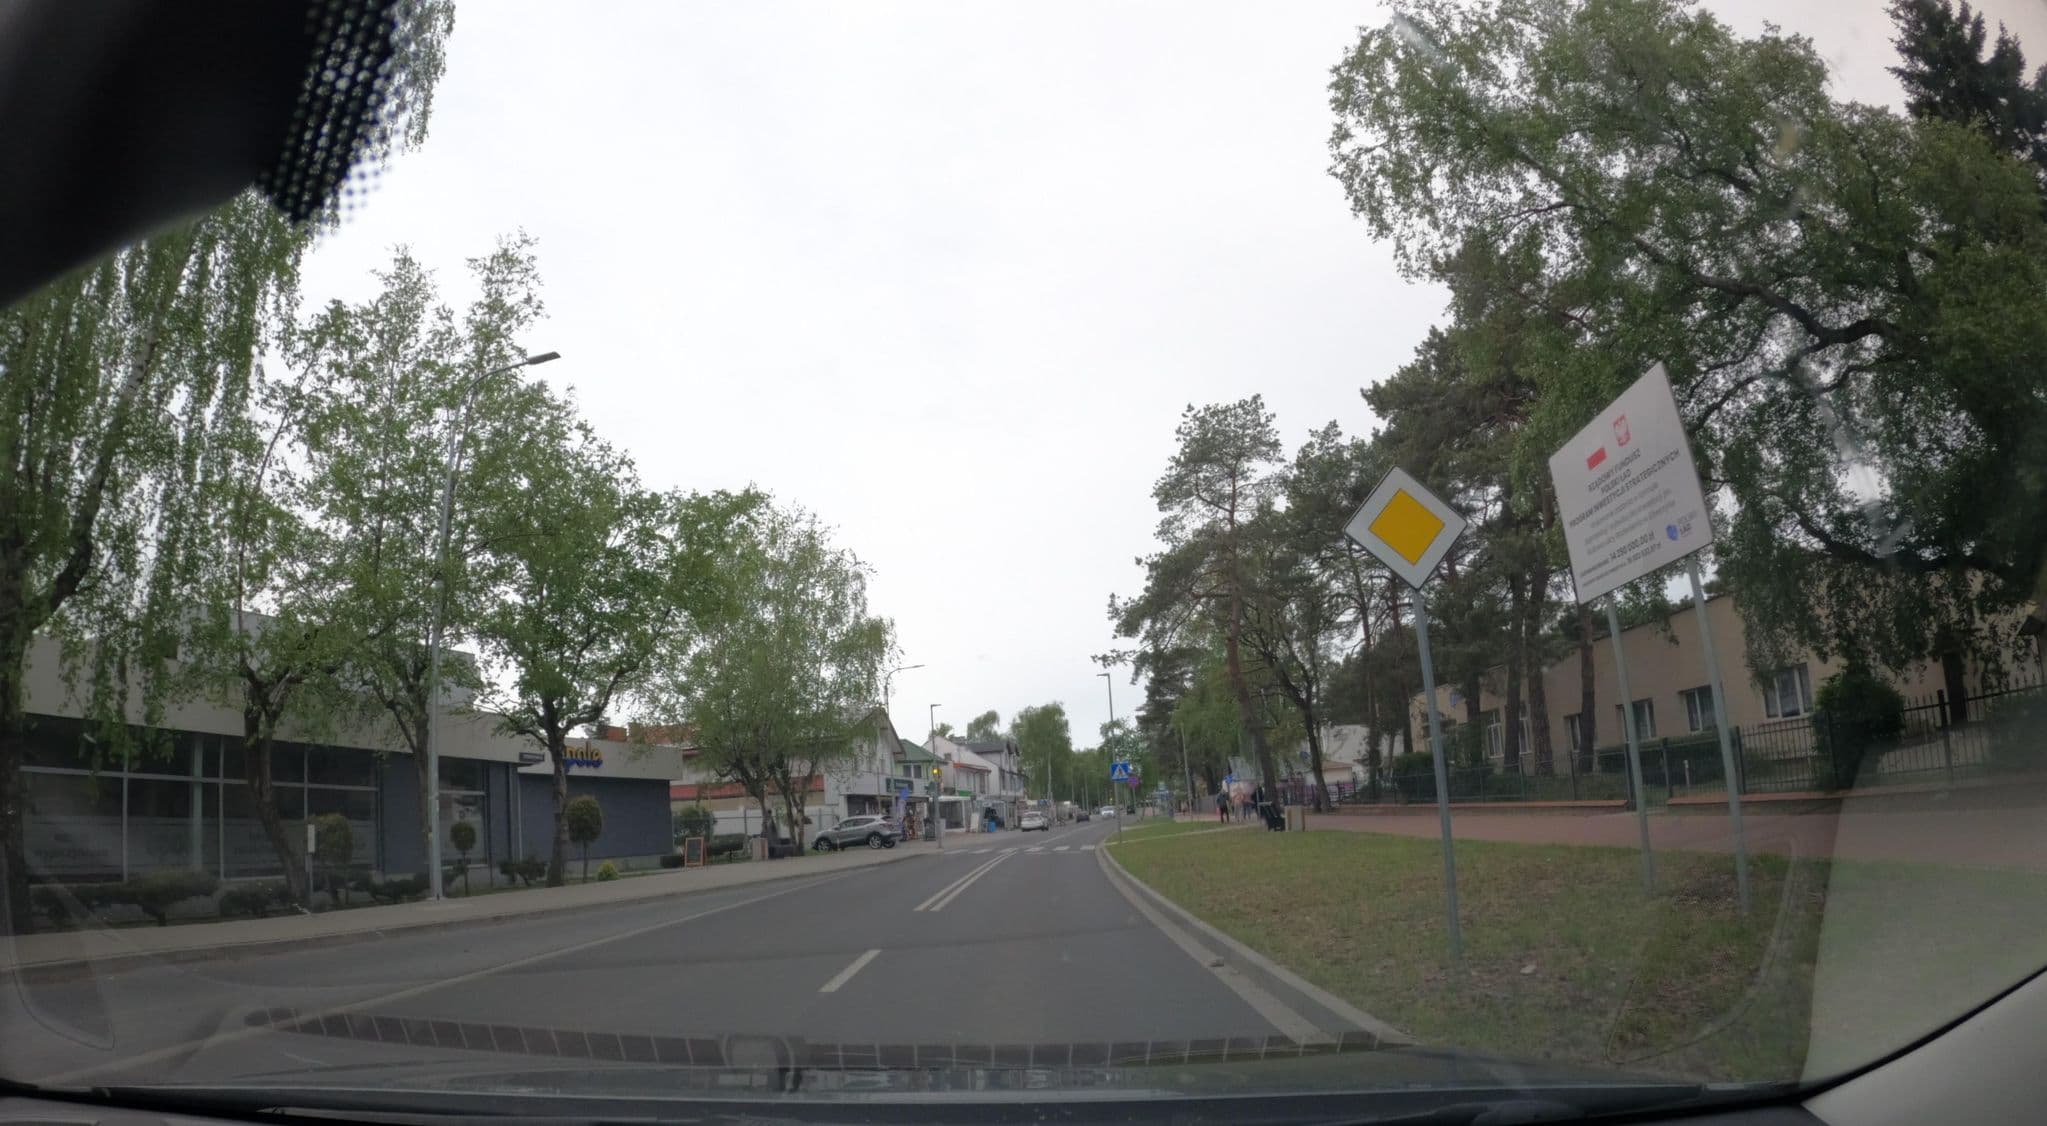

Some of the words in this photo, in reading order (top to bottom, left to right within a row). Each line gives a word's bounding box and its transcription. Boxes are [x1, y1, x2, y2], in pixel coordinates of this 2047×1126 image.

[1614, 448, 1641, 473] FUNDUSZ
[1569, 507, 1594, 528] PROGRAM
[1593, 485, 1626, 512] INWESTYCJI
[1626, 448, 1679, 490] STRATEGICZNYCH
[1600, 475, 1620, 494] POLSKI
